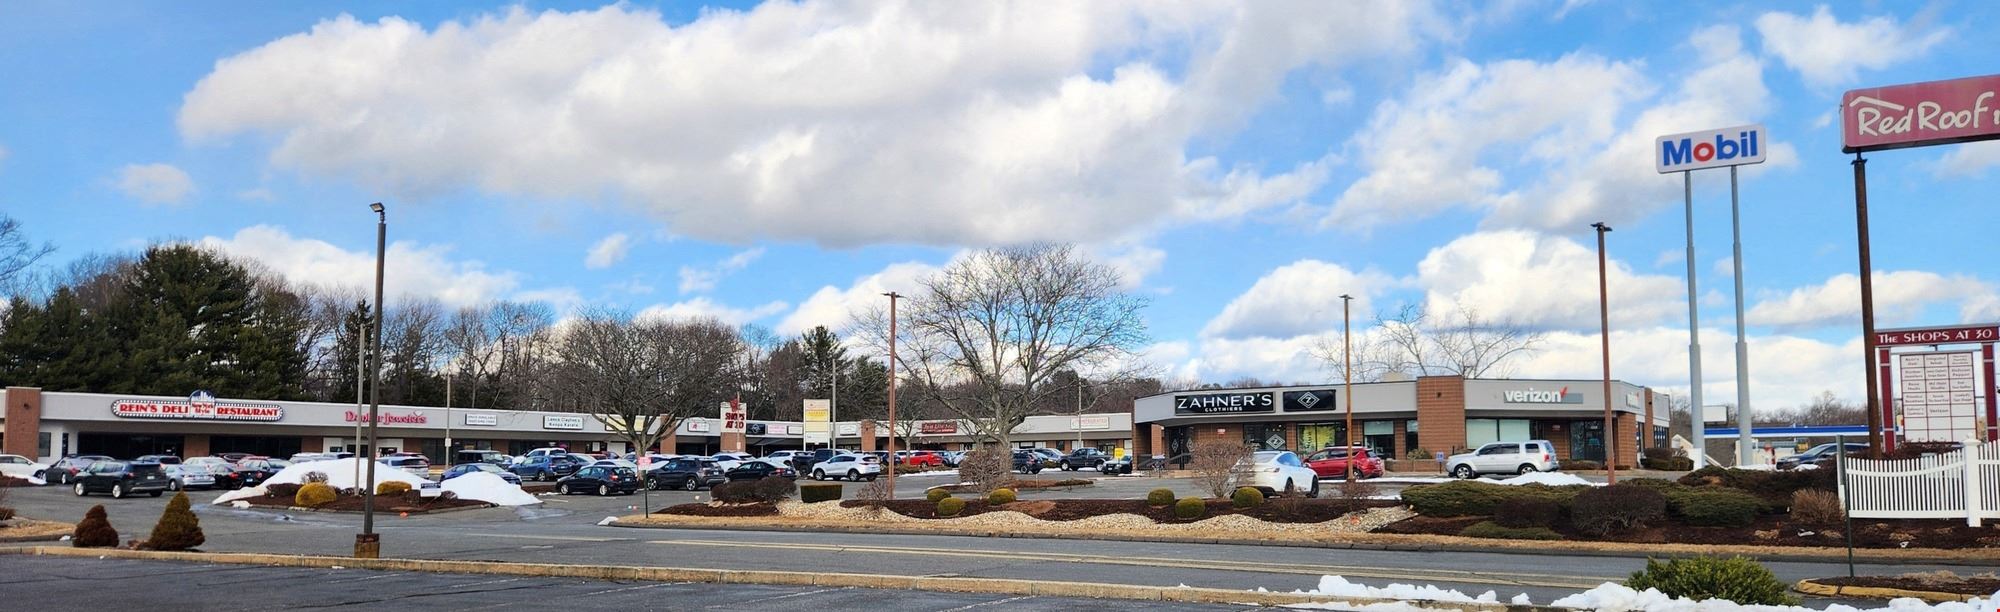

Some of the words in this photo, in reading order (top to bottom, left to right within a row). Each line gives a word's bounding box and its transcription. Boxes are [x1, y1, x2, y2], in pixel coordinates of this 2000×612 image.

[1858, 107, 1914, 136] Red
[1917, 91, 1995, 131] Roof
[1662, 130, 1758, 166] Mobil
[1903, 331, 1950, 343] SHOPS
[1955, 329, 1971, 340] AT
[1976, 329, 1992, 339] 30
[1177, 393, 1272, 409] ZAHNER'S
[1504, 387, 1562, 403] verizon
[120, 403, 157, 413] REIN'S
[162, 404, 188, 414] DELI
[217, 406, 279, 417] RESTAURANT
